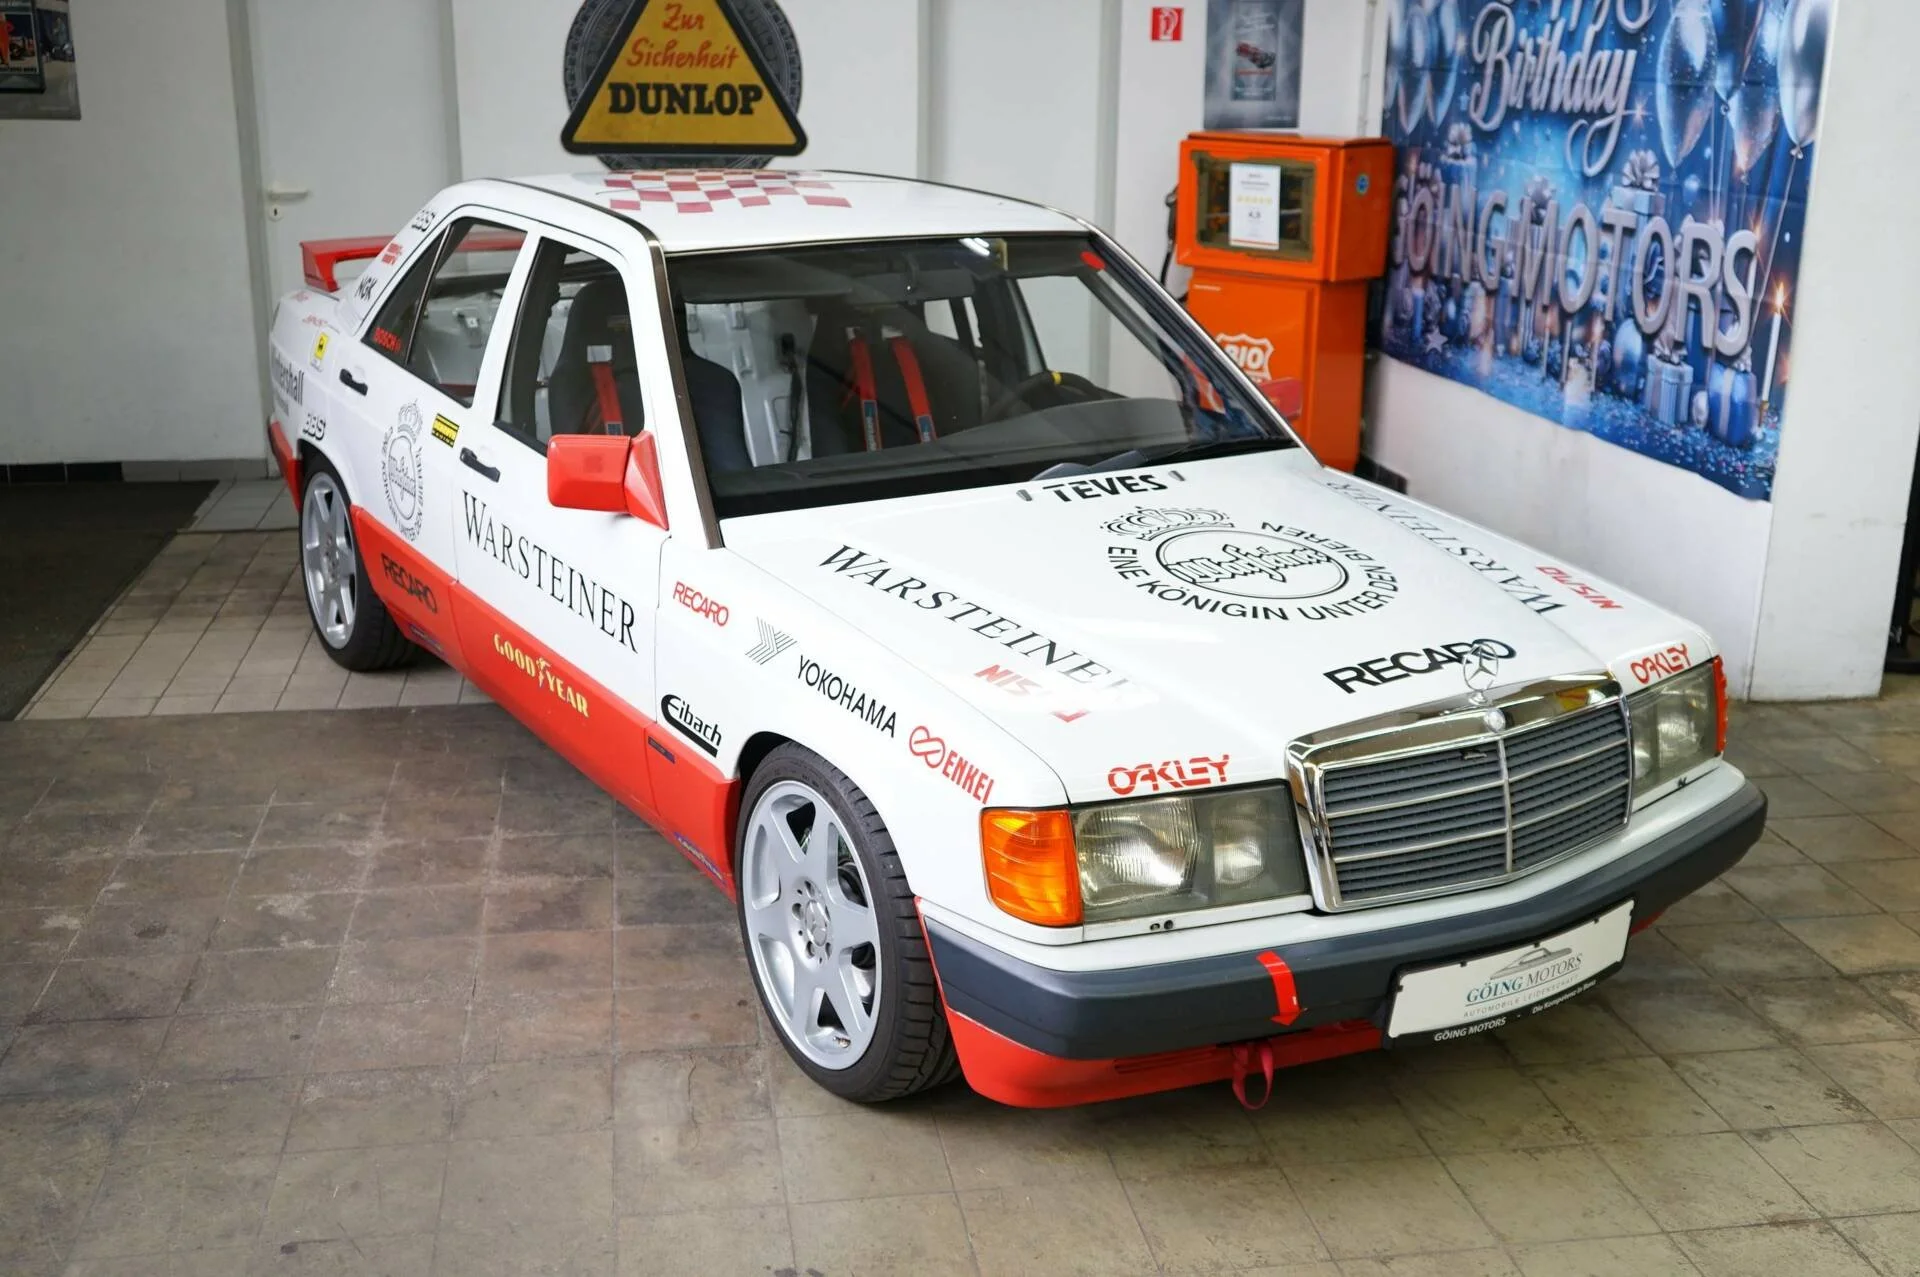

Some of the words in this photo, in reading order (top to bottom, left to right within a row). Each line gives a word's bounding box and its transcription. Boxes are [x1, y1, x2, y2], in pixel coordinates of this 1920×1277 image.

[662, 3, 704, 31] Zur
[627, 36, 739, 70] Sicherheit
[608, 82, 763, 116] DUNLOP
[1469, 2, 1640, 177] Birthday
[354, 275, 378, 301] NGK
[1511, 196, 1758, 357] MOTORS
[1042, 474, 1168, 502] TEVES
[1261, 521, 1374, 562] BIEREN
[1326, 481, 1567, 614] WARSTEINER
[379, 552, 438, 614] RECARO
[462, 490, 639, 654] WARSTEINER
[1108, 546, 1151, 580] EINE
[1360, 564, 1398, 593] DEN
[673, 580, 729, 627] RECARO
[818, 544, 1131, 690] WARSTEINE
[1137, 580, 1290, 621] KÖNIGIN
[1297, 590, 1390, 621] UNTER
[1323, 638, 1516, 694] RECARO
[1630, 643, 1692, 685] OAKLEY
[797, 654, 897, 739] YOKOHAMA
[660, 693, 722, 758] Eibach
[942, 750, 995, 805] ENKEI
[1107, 754, 1230, 796] OAKLEY
[1466, 976, 1523, 1004] GÖING
[1525, 952, 1583, 988] MOTORS
[1434, 1027, 1467, 1042] GÖING
[1468, 1016, 1507, 1034] MOTORS
